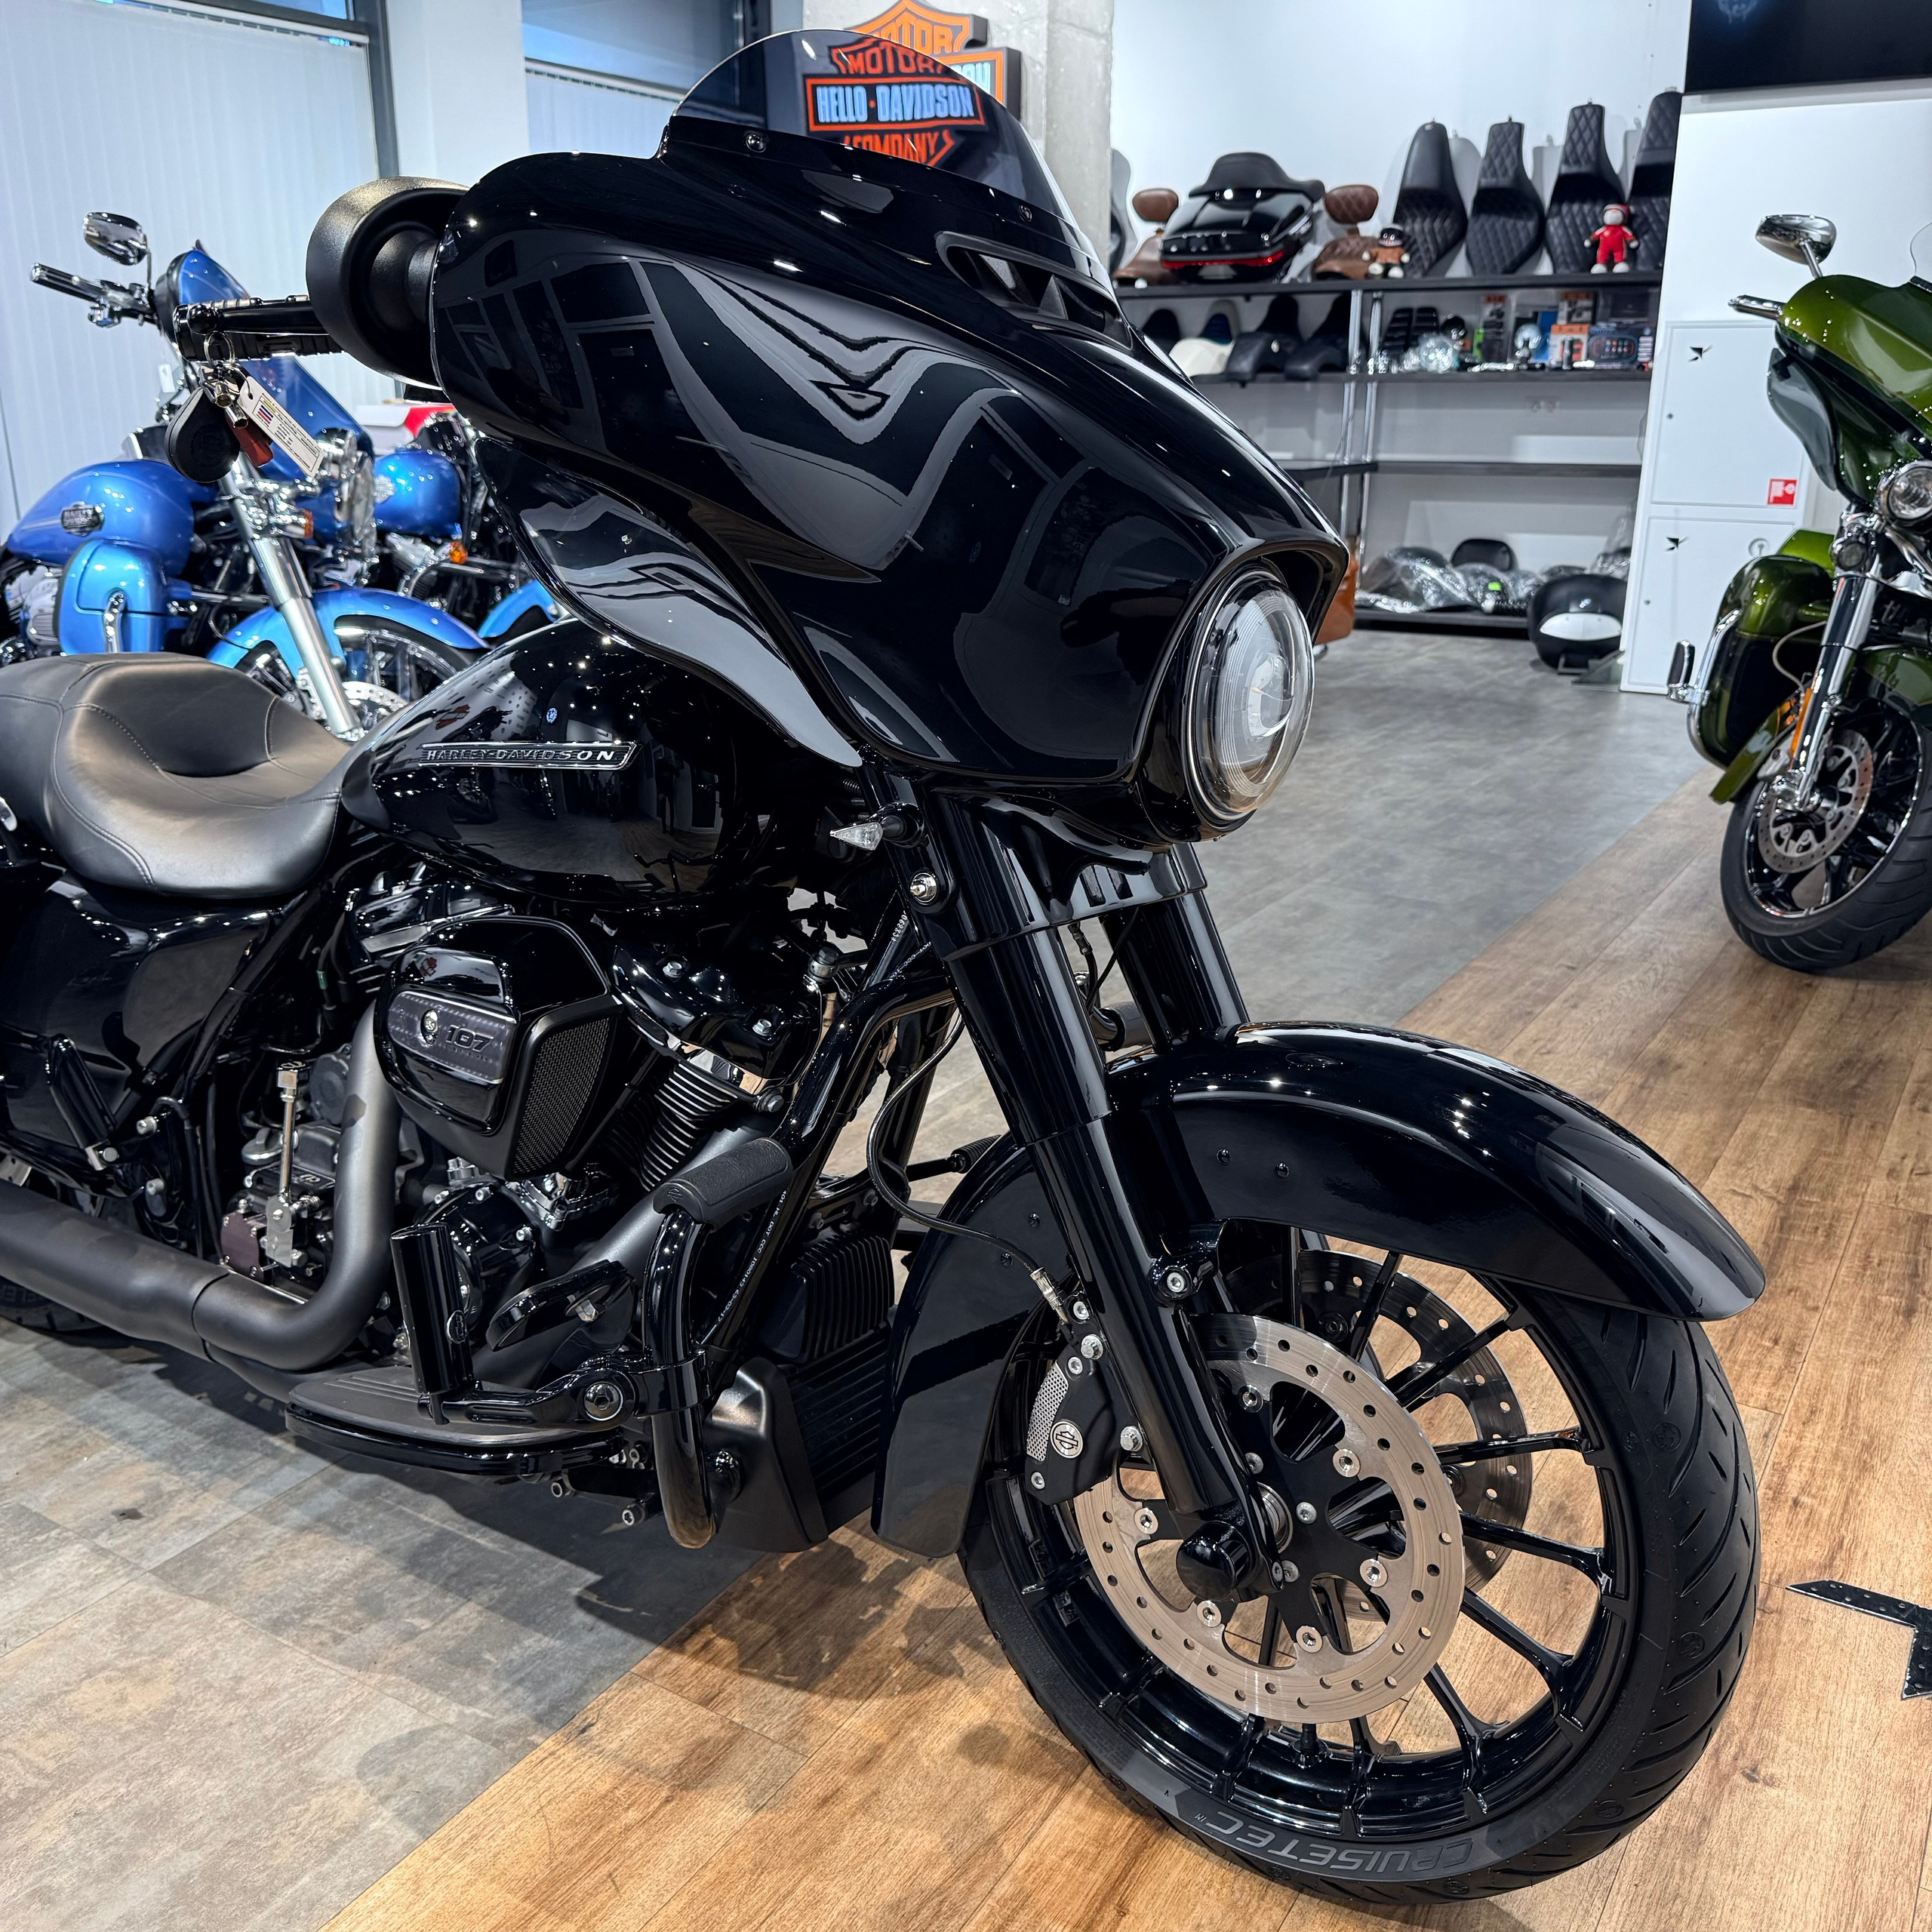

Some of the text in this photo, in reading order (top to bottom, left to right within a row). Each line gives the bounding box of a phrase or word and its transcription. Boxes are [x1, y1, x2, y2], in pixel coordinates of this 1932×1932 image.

[848, 41, 936, 74] MOTOR
[816, 84, 975, 123] HELLO DAVIDSON
[426, 749, 615, 761] HARLEY-DAVIDSON
[445, 1024, 494, 1053] 107
[765, 1220, 774, 1236] DOT
[757, 1238, 767, 1254] CCC
[1204, 1811, 1475, 1874] CRUISETEC
